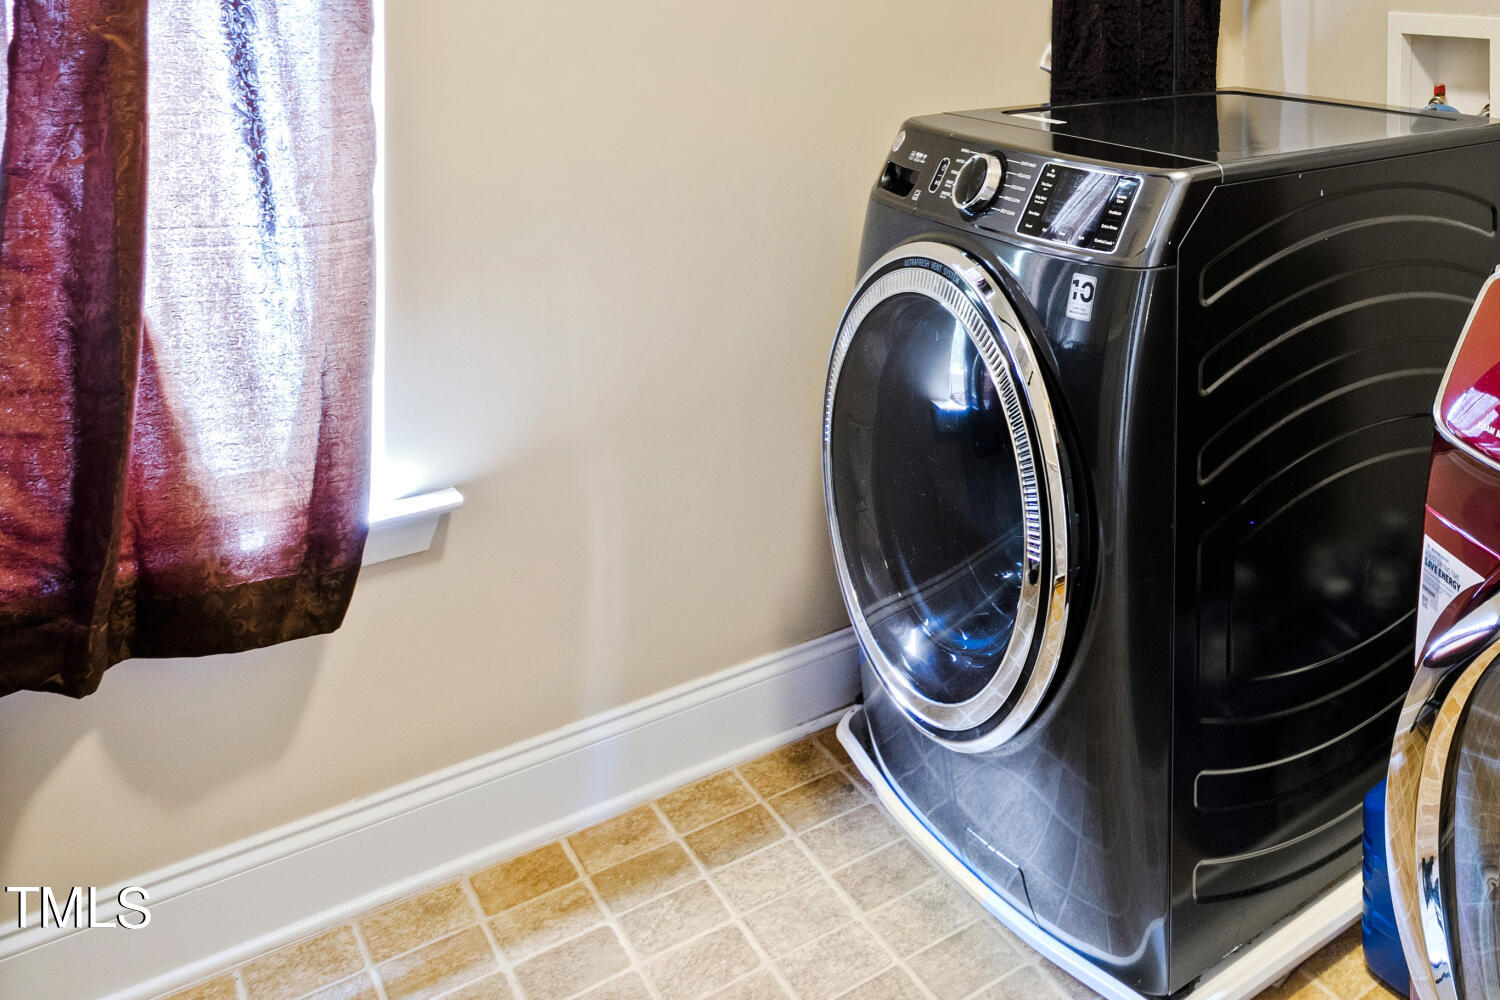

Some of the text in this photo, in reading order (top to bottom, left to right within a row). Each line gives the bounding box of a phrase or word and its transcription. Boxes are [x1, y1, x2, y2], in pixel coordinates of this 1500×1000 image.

[930, 261, 943, 272] VENT
[943, 267, 960, 284] SYSTEM
[1424, 557, 1438, 576] SAVE
[1438, 571, 1461, 592] ENERGY
